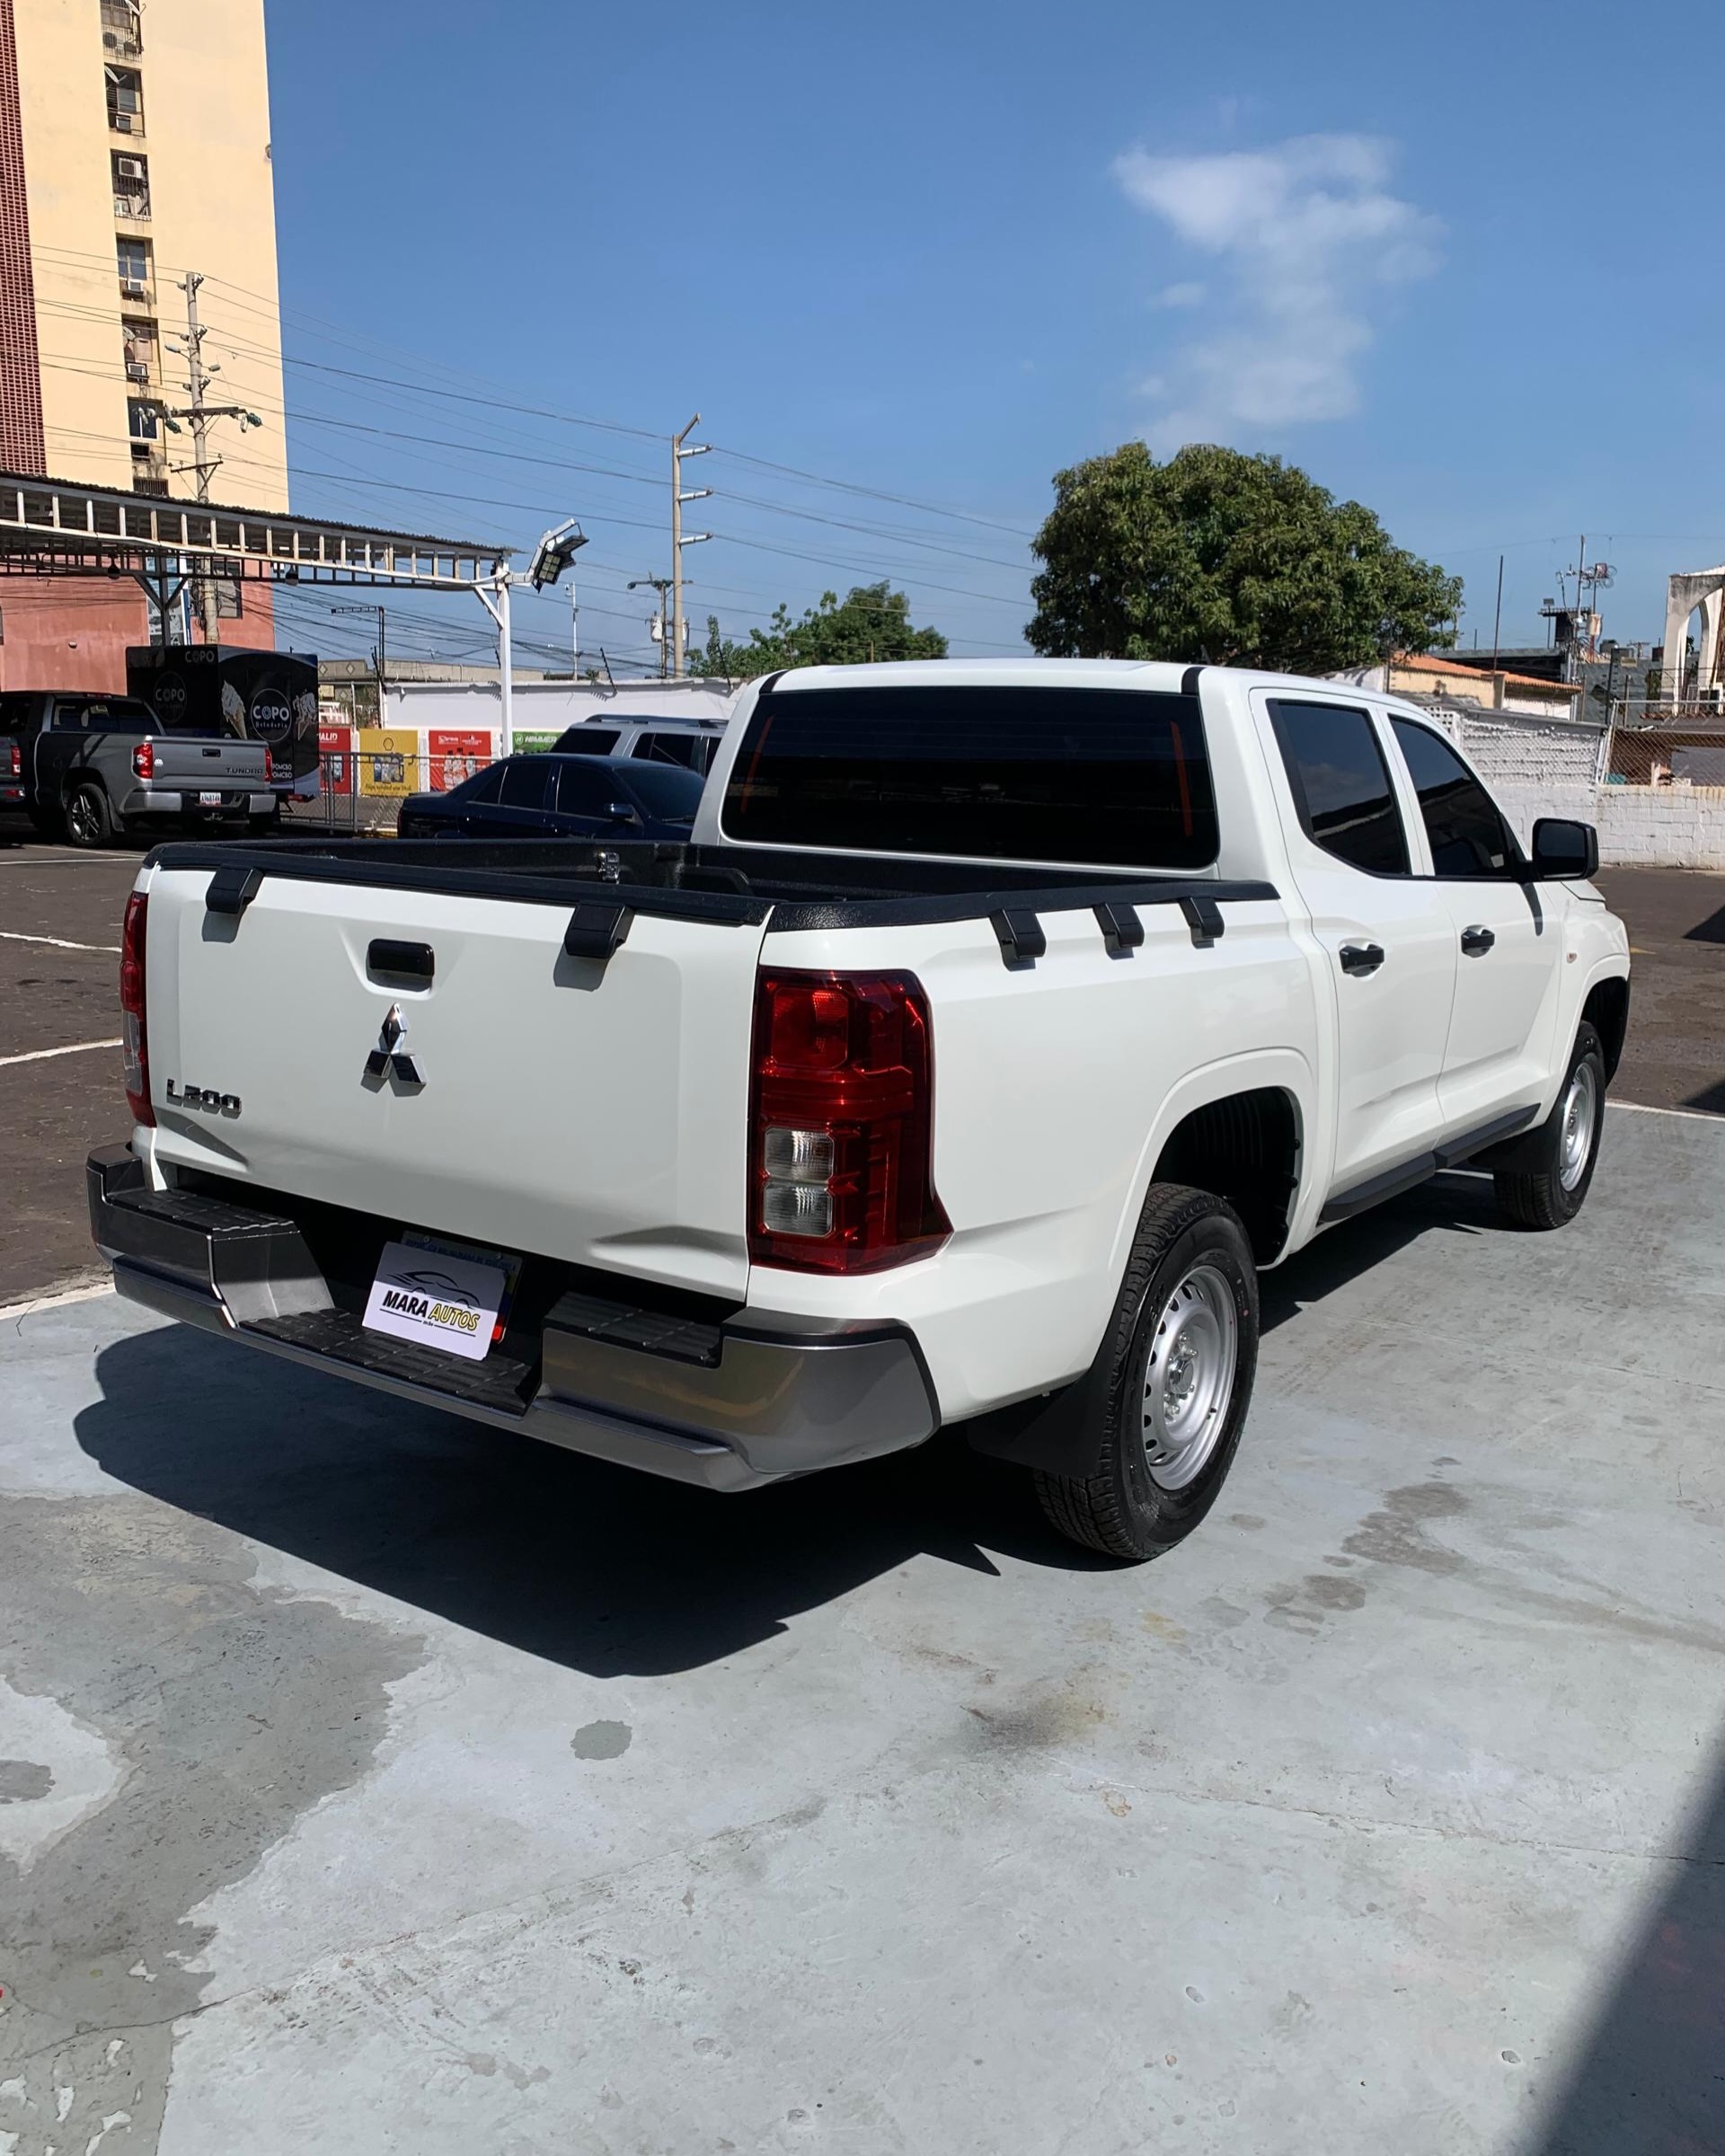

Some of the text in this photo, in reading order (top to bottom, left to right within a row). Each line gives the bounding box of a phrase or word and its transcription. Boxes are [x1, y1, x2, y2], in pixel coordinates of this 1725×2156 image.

[184, 649, 215, 663] COPO
[155, 688, 185, 702] COPO
[252, 705, 289, 721] COPO
[166, 1078, 243, 1118] L200
[382, 1290, 481, 1331] MARA AUTOS
